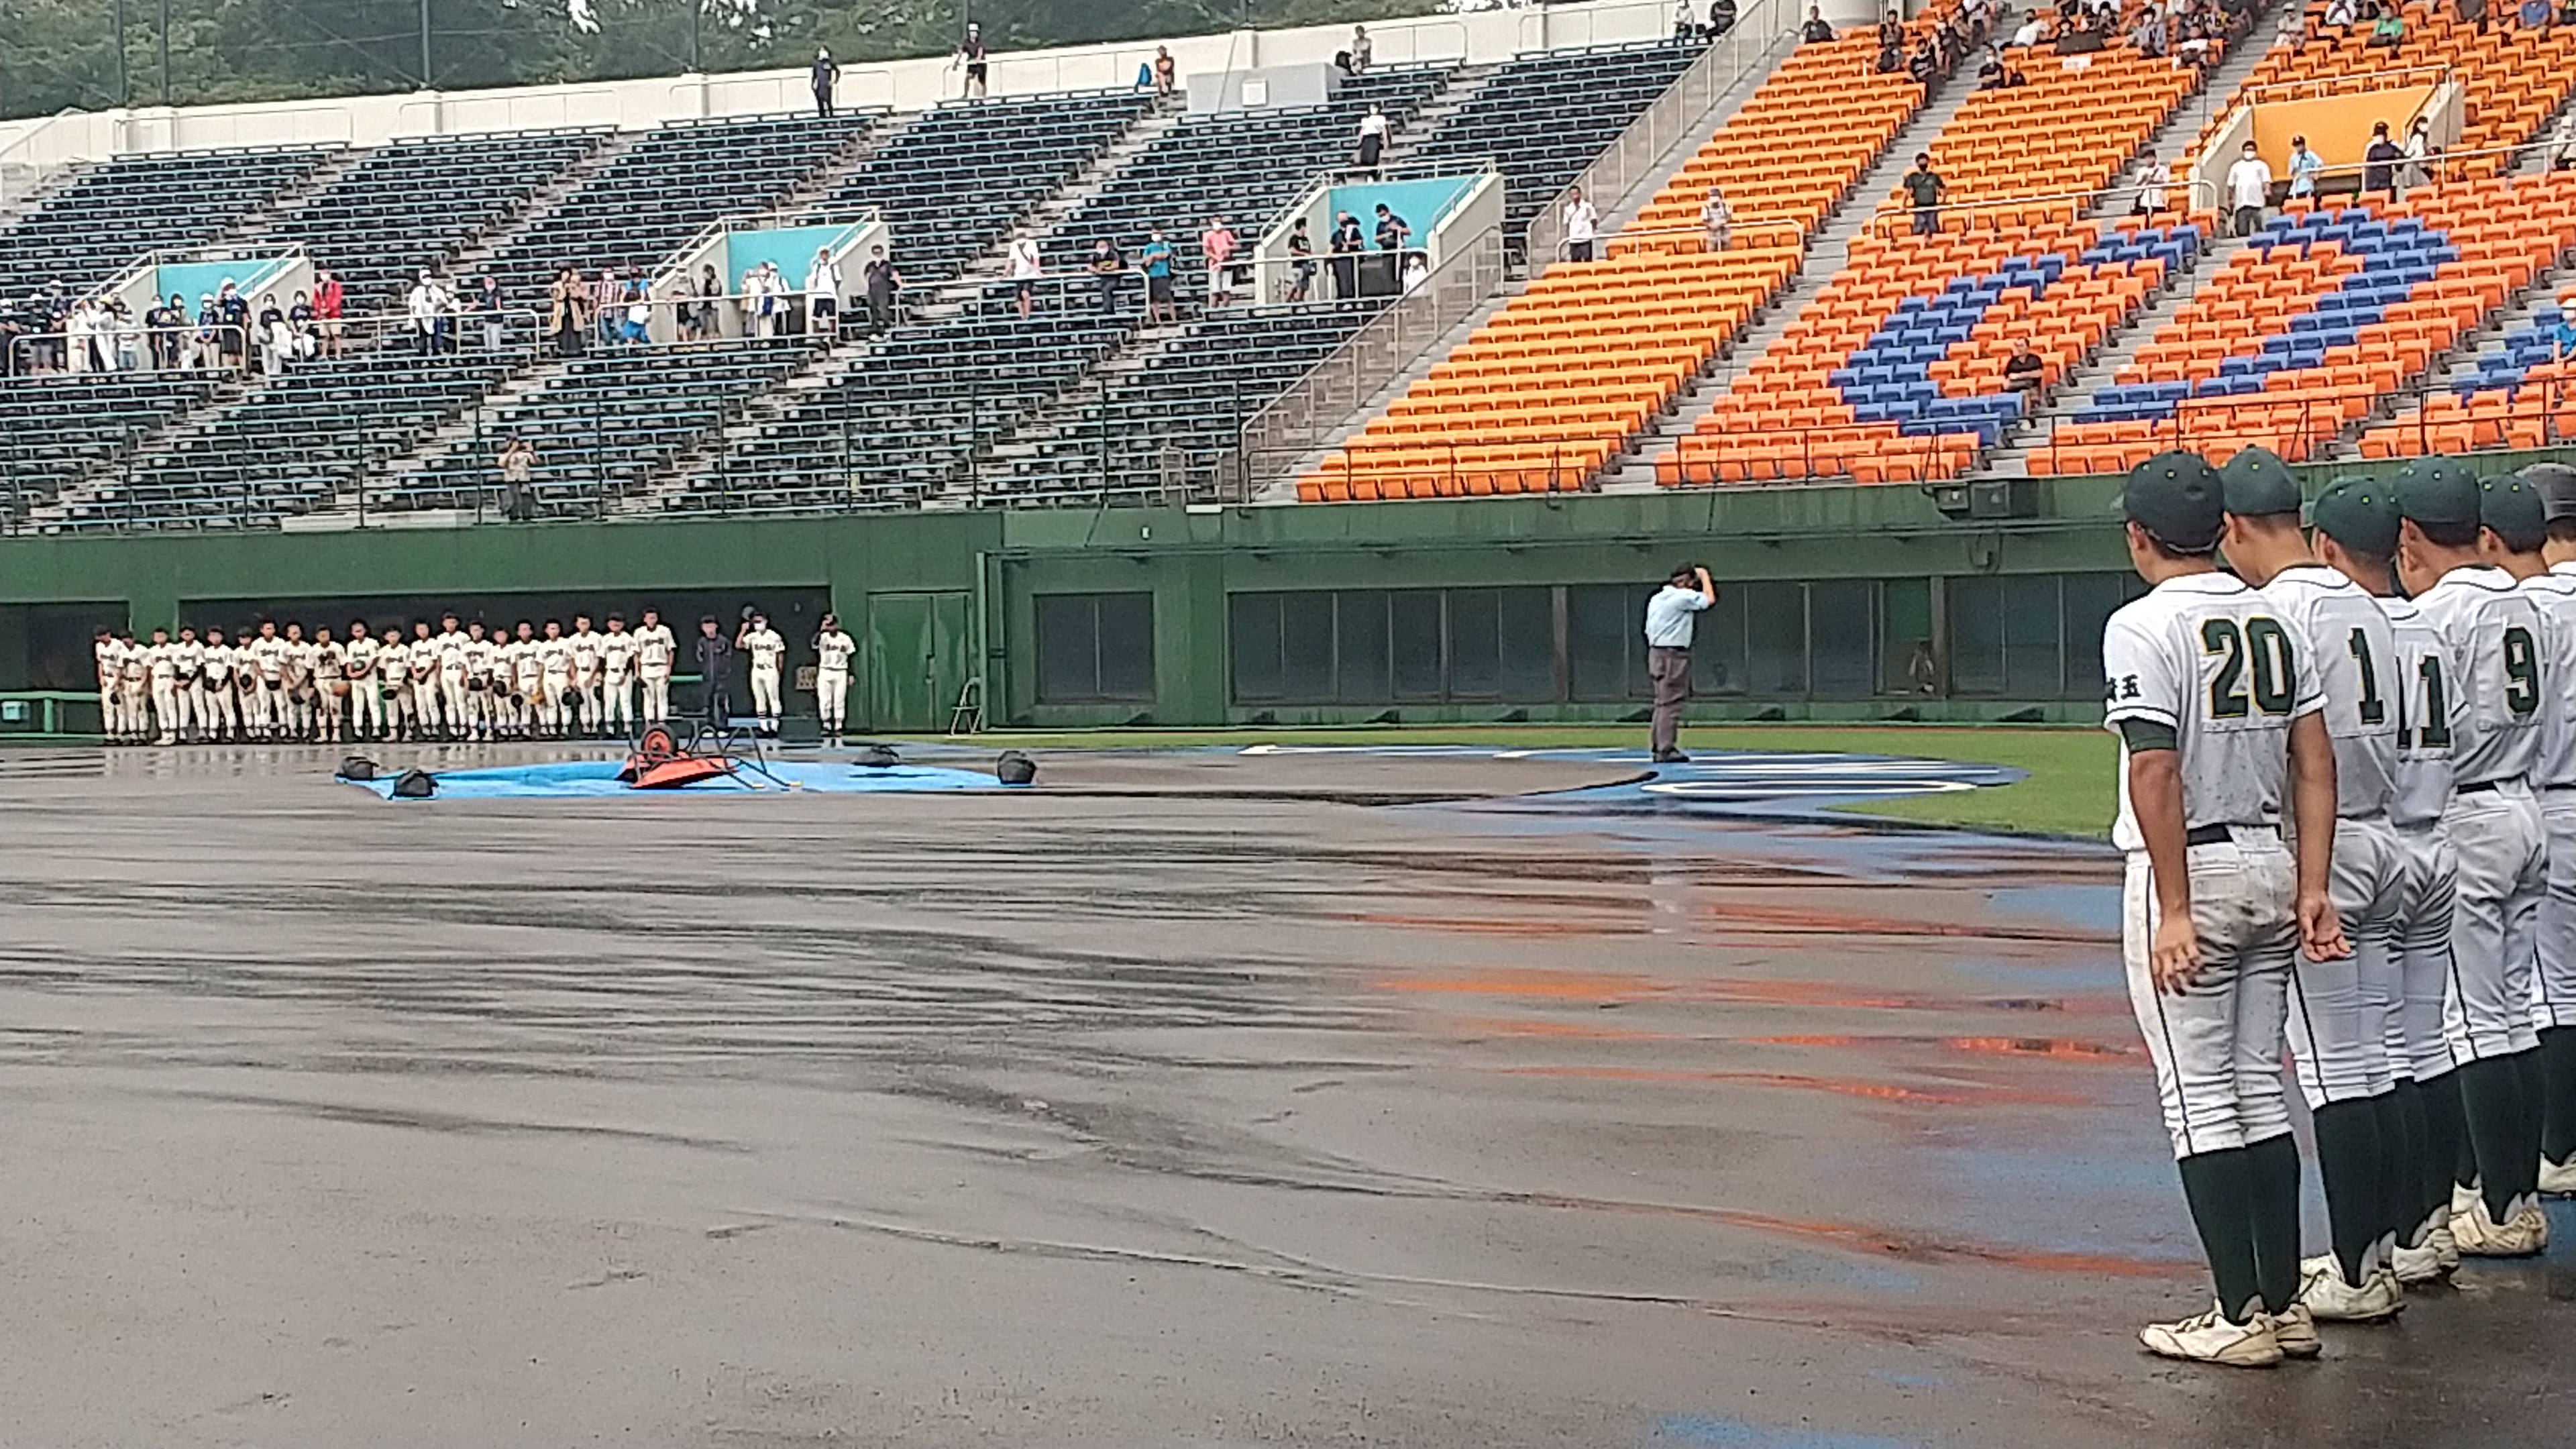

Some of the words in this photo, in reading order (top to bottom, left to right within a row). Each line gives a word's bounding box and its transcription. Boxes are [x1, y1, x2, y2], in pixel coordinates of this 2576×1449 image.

[2200, 617, 2295, 719] 20
[2348, 628, 2384, 724] 1
[2504, 627, 2540, 715] 9
